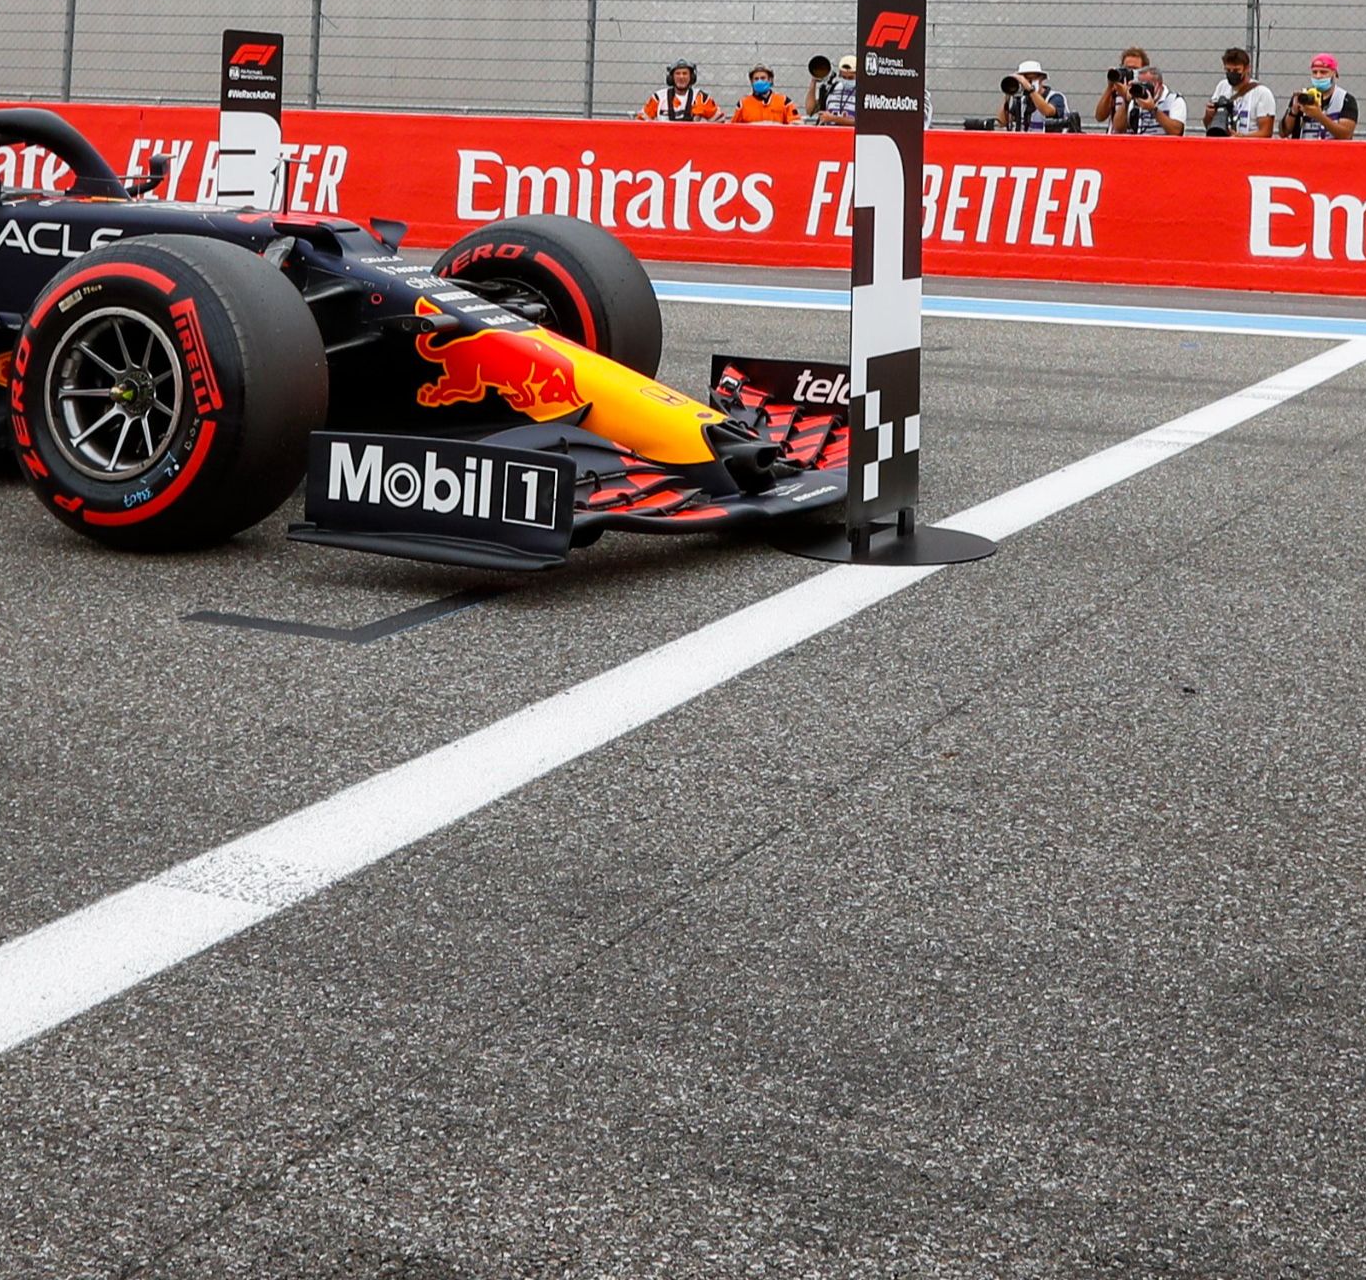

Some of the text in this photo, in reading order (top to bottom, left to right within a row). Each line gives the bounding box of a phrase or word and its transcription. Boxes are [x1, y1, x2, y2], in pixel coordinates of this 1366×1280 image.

[863, 94, 919, 111] #WeRaceAsOne
[456, 148, 1103, 248] Emirates FL BETTER
[438, 243, 528, 278] ERO
[169, 297, 223, 416] PIRELLI
[328, 442, 540, 521] Mobil 1
